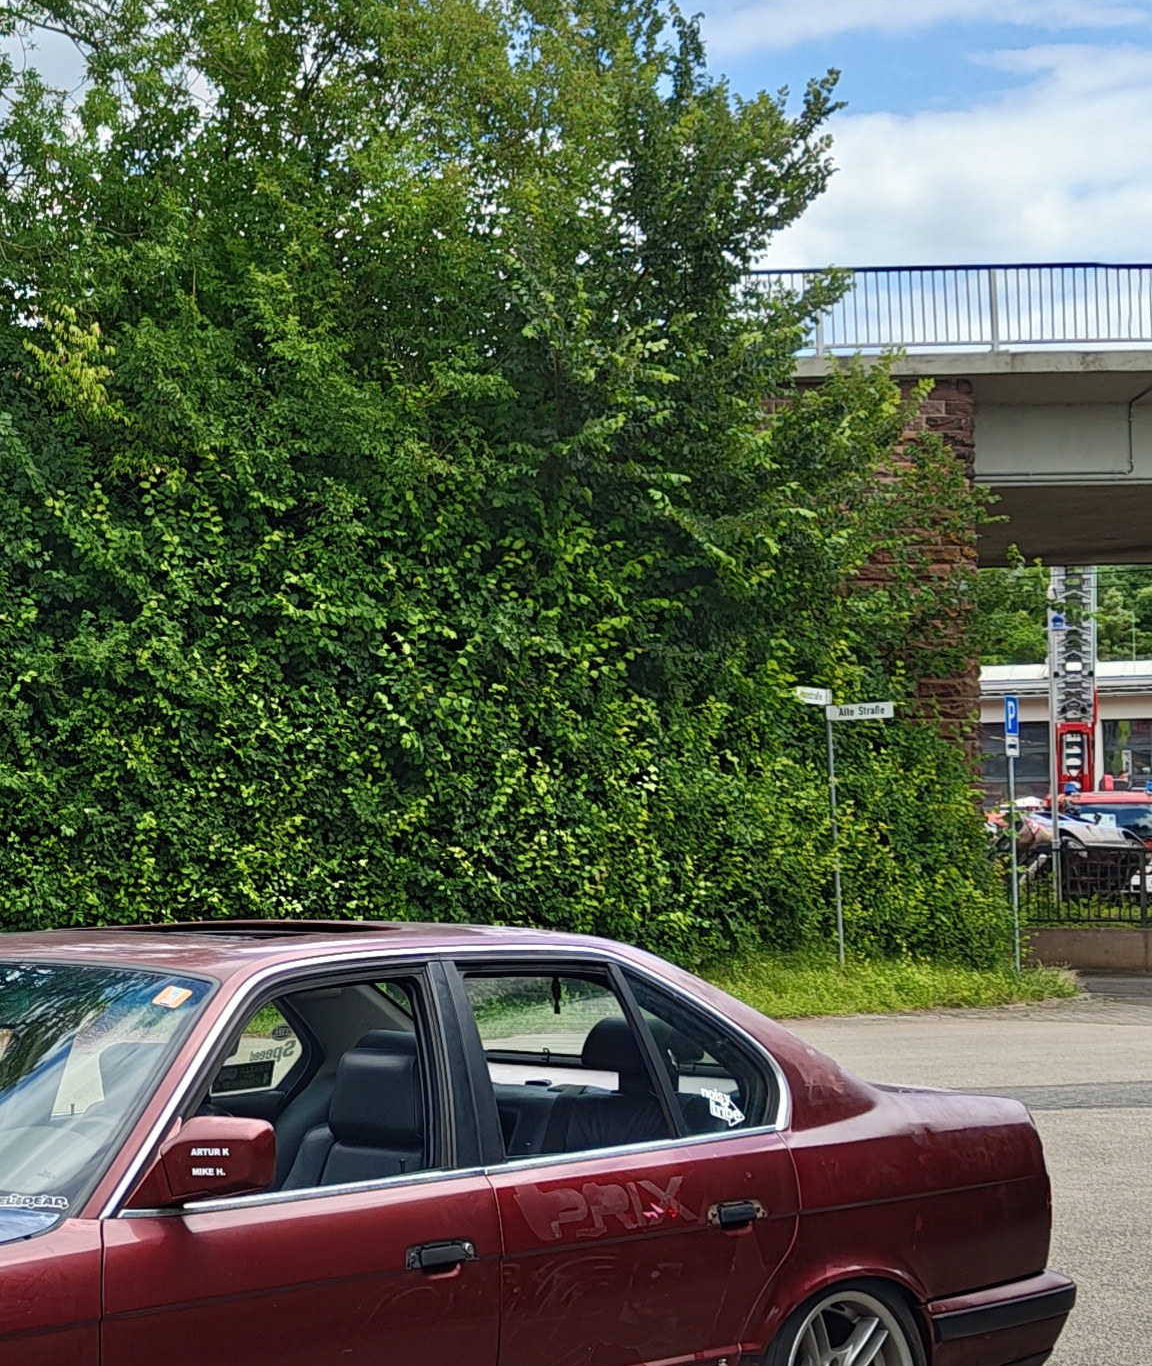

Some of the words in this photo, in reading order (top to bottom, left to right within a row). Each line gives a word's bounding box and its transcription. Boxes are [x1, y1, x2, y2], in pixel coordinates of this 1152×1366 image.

[838, 707, 855, 717] Alte
[858, 705, 886, 716] Straße
[1007, 700, 1016, 729] P
[700, 1087, 731, 1107] noisy
[710, 1103, 743, 1122] tribe
[190, 1147, 221, 1157] ARTUR
[222, 1147, 230, 1157] K
[191, 1167, 215, 1177] MIKE
[215, 1167, 227, 1177] H.
